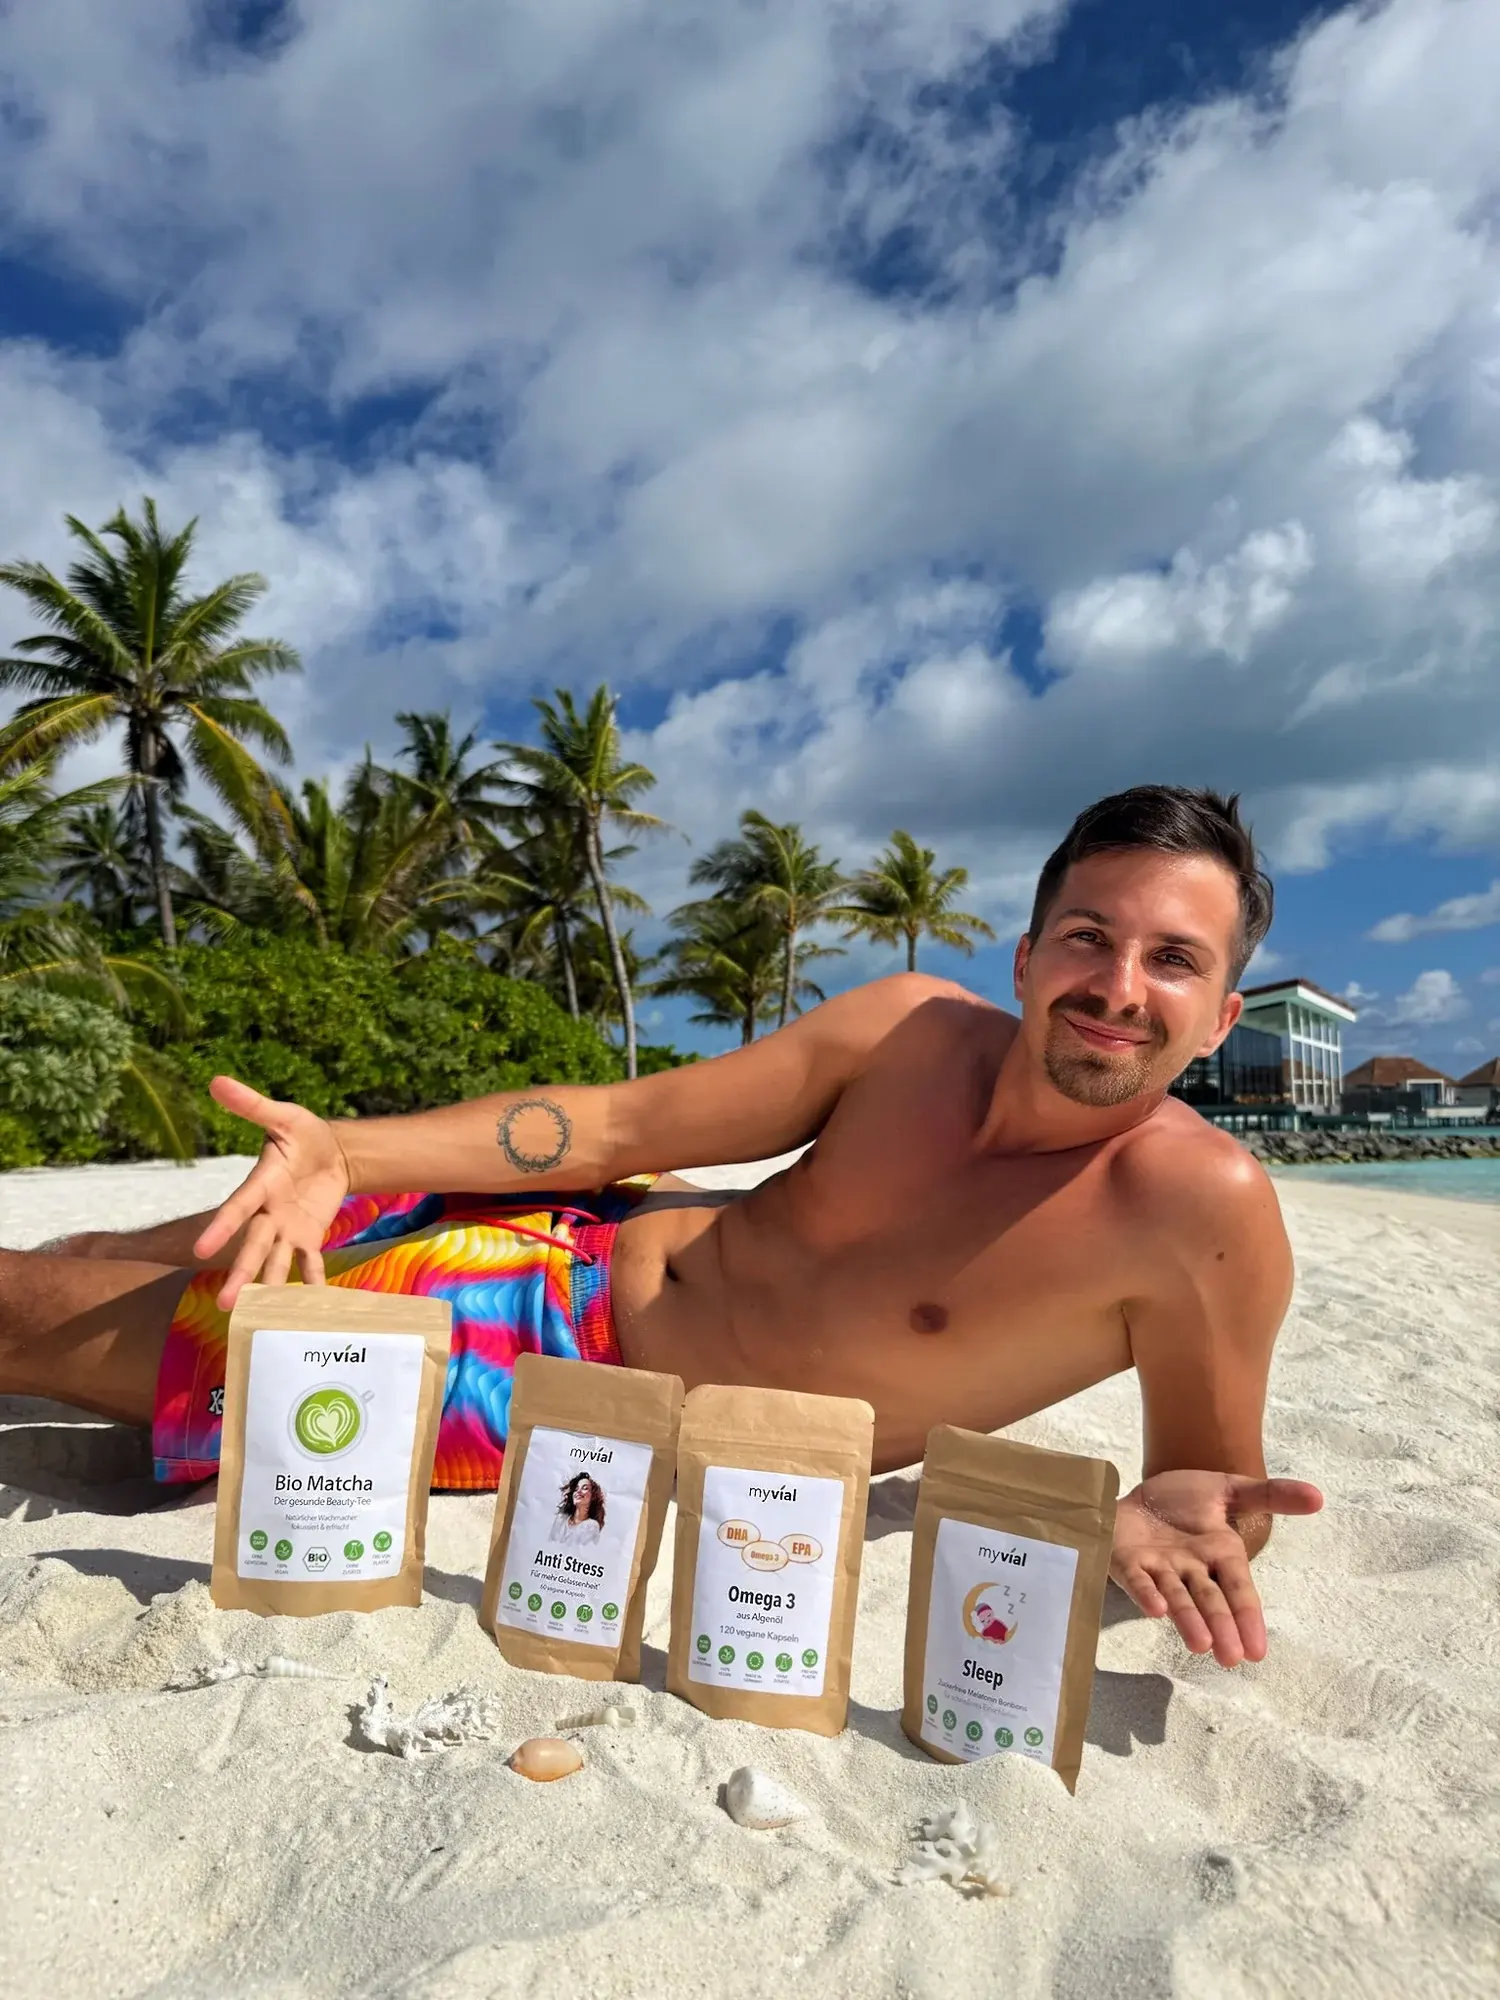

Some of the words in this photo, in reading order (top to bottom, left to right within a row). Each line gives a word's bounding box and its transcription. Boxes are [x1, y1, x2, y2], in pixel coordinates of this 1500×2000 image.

[275, 1475, 303, 1492] Bio
[307, 1475, 374, 1492] Matcha
[274, 1496, 287, 1505] Der
[288, 1496, 325, 1507] gesunde
[326, 1496, 371, 1507] Beauty-Tee
[727, 1527, 748, 1542] DHA
[750, 1550, 774, 1562] Omega
[792, 1542, 811, 1556] EPA
[534, 1550, 562, 1569] Anti
[563, 1556, 605, 1578] Stress
[530, 1569, 540, 1578] Für
[541, 1573, 557, 1581] mehr
[728, 1585, 782, 1611] Omega
[785, 1593, 796, 1609] 3
[736, 1612, 750, 1621] aus
[751, 1613, 783, 1624] Algenöl
[719, 1625, 735, 1635] 120
[735, 1629, 766, 1640] vegane
[767, 1631, 799, 1643] Kapseln
[962, 1659, 1003, 1690] Sleep
